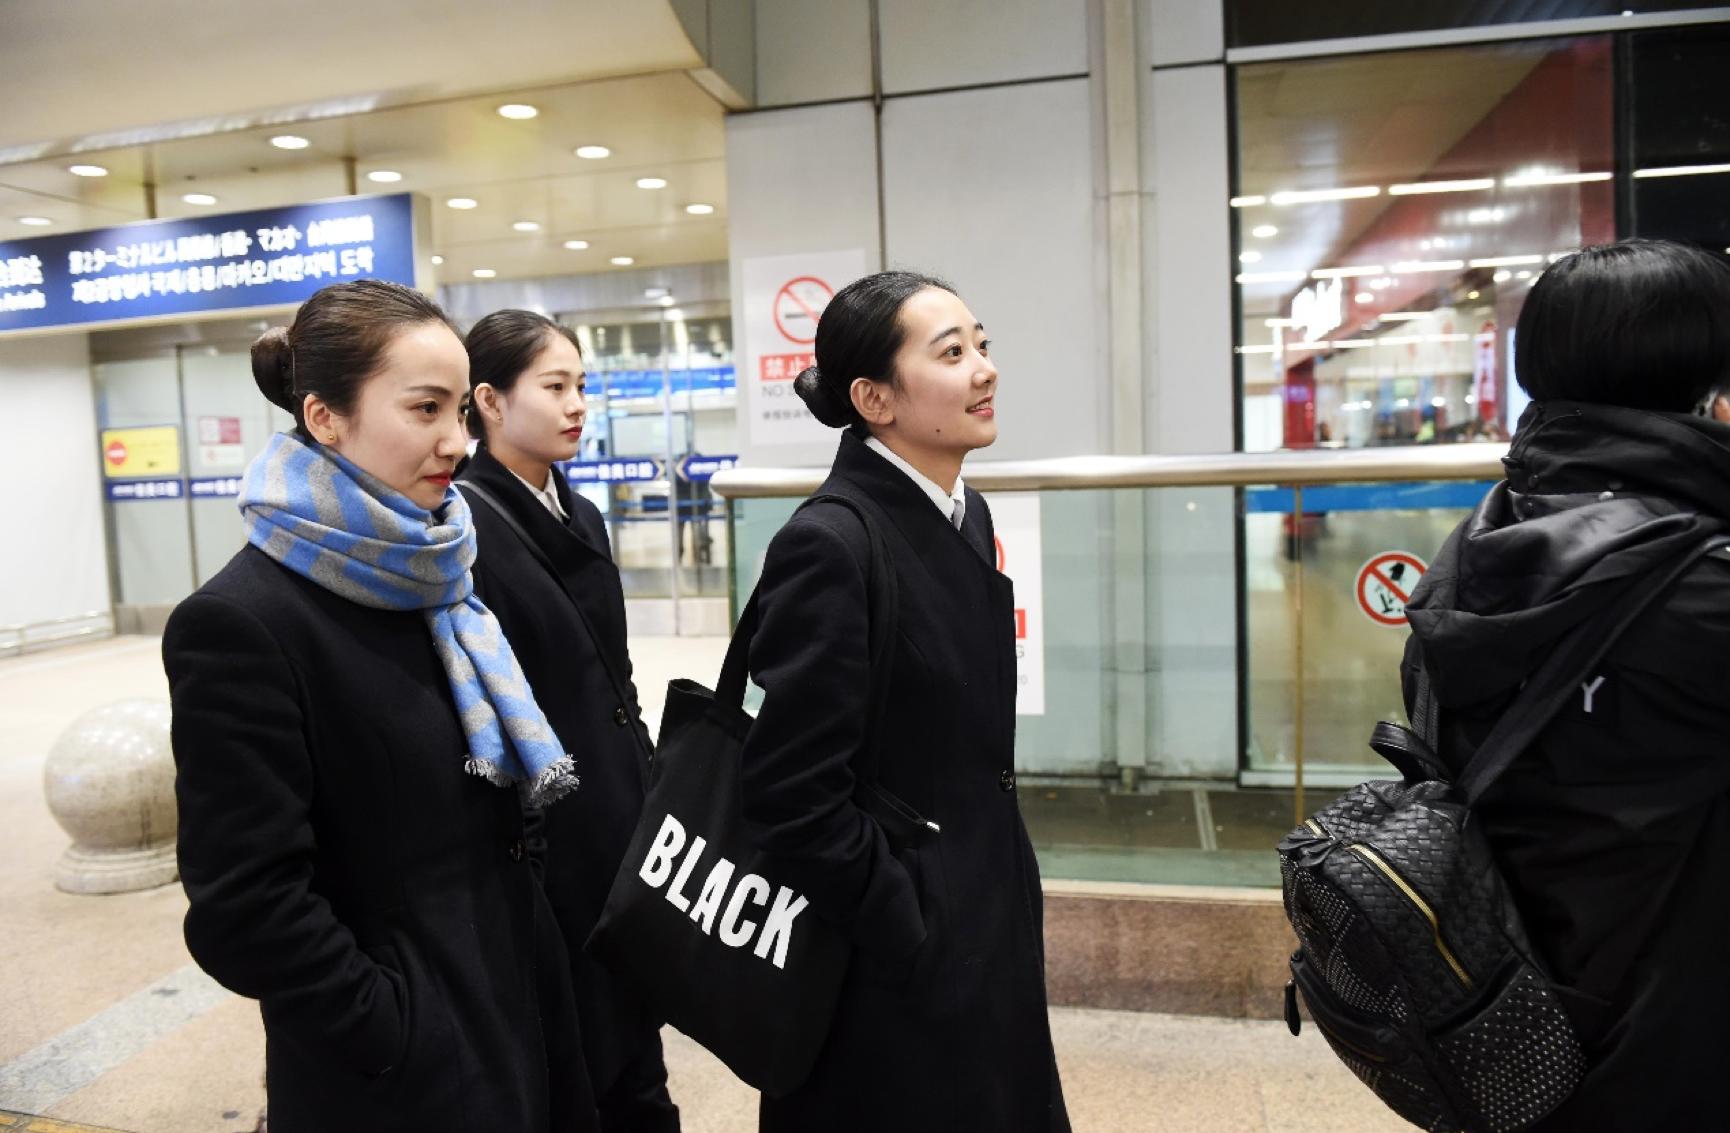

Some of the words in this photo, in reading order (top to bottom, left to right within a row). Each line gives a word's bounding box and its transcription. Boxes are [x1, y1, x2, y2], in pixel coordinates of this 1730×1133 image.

[765, 356, 817, 379] 禁止
[762, 385, 784, 397] NO
[639, 814, 809, 969] BLACK
